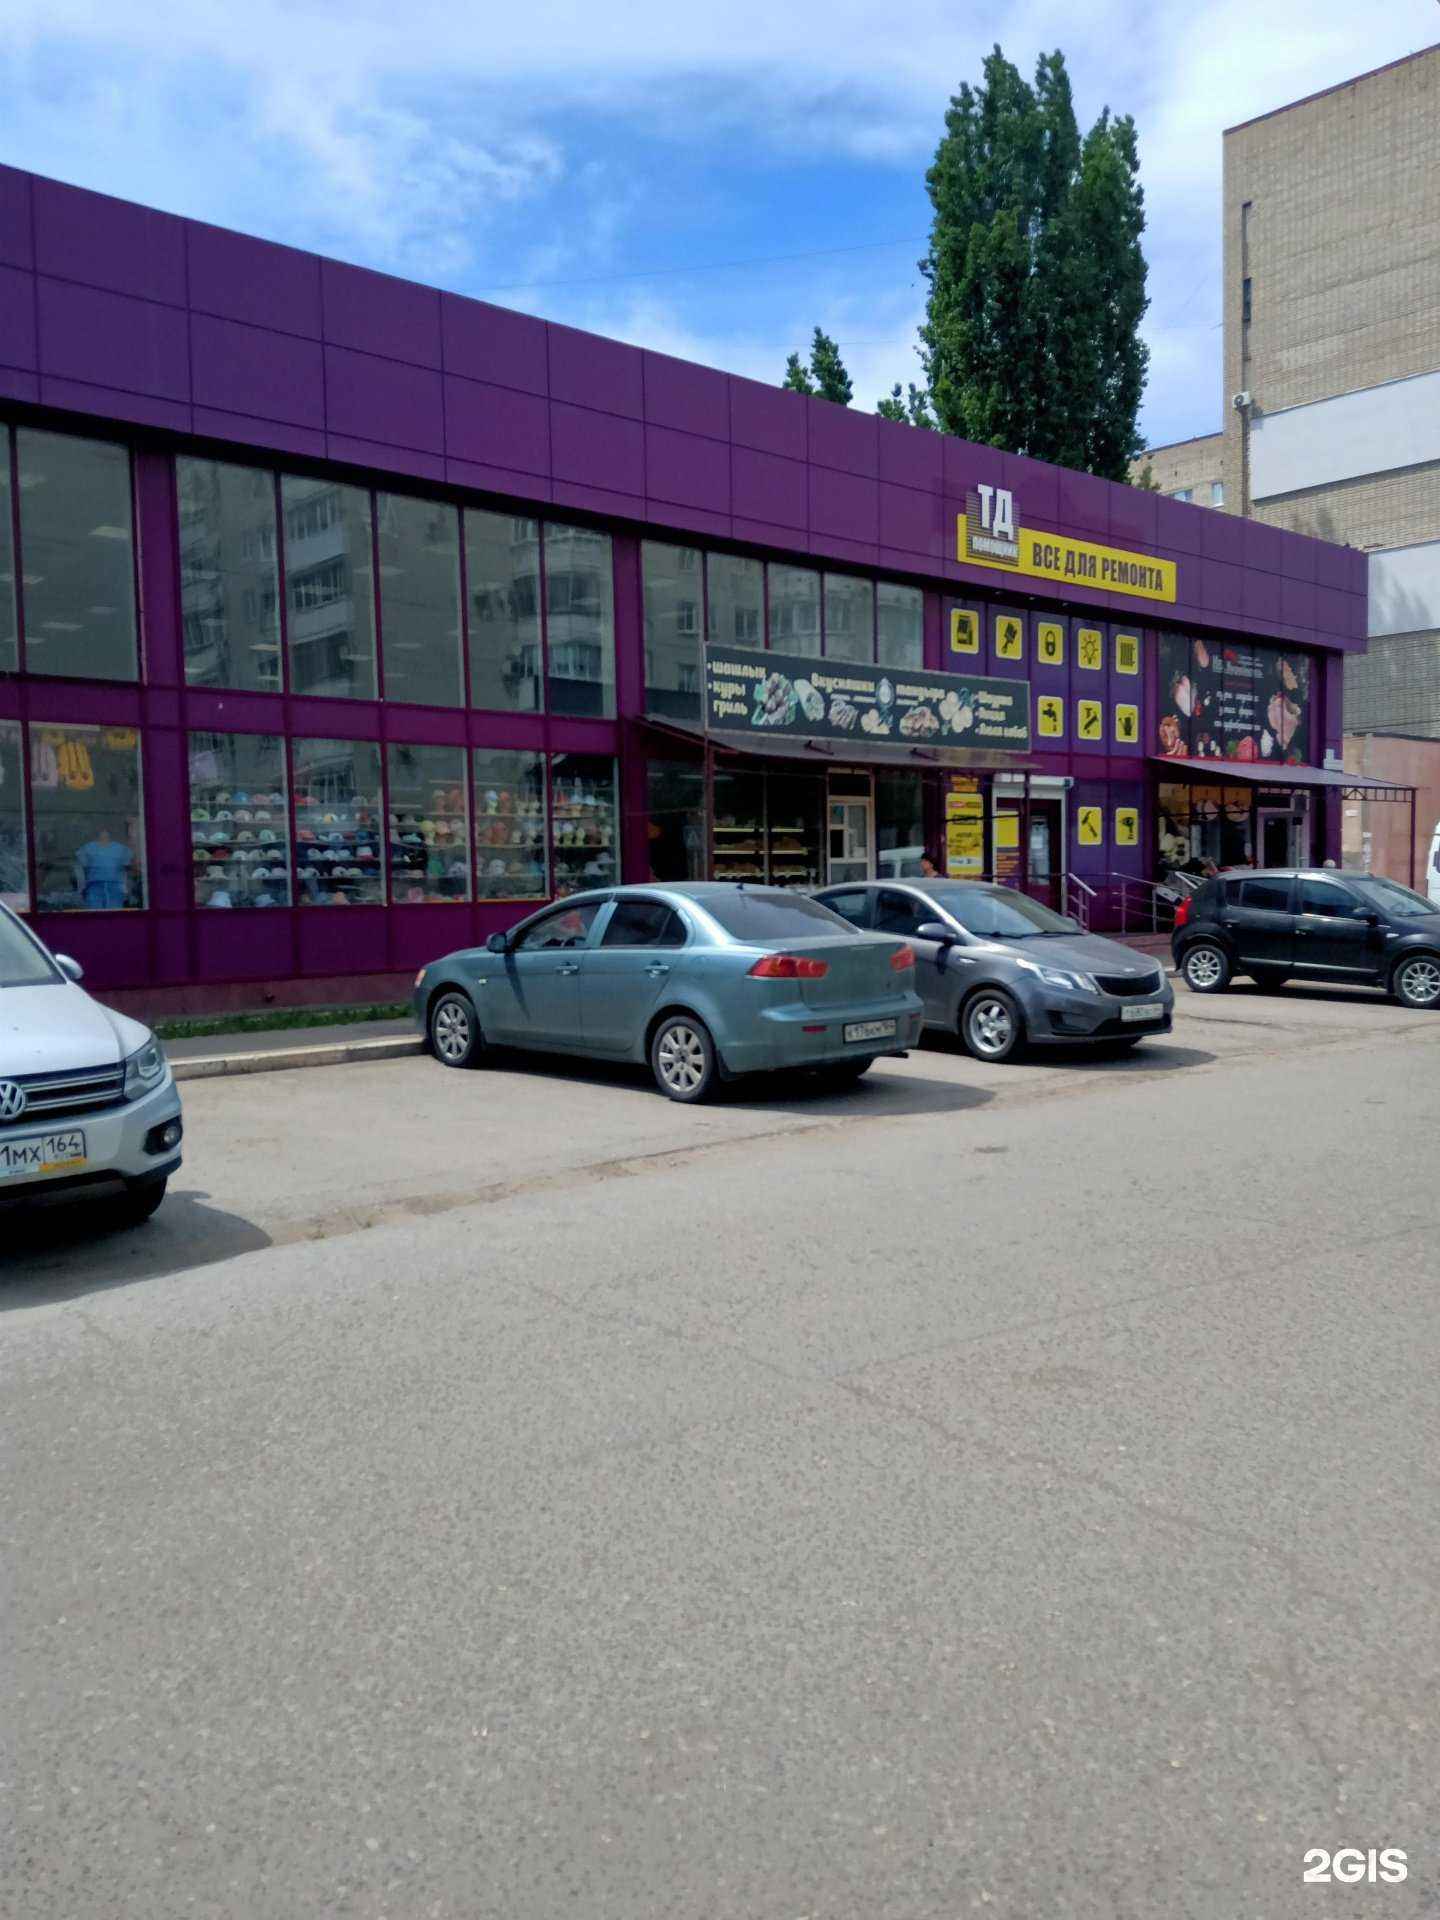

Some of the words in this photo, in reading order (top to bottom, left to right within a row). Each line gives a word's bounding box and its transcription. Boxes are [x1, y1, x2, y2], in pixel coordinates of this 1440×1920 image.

[978, 484, 1014, 540] ТД
[1032, 543, 1060, 570] ВСЕ
[1064, 550, 1096, 578] ДЛЯ
[1101, 557, 1163, 591] РЕМОНТА
[47, 1134, 81, 1153] 164
